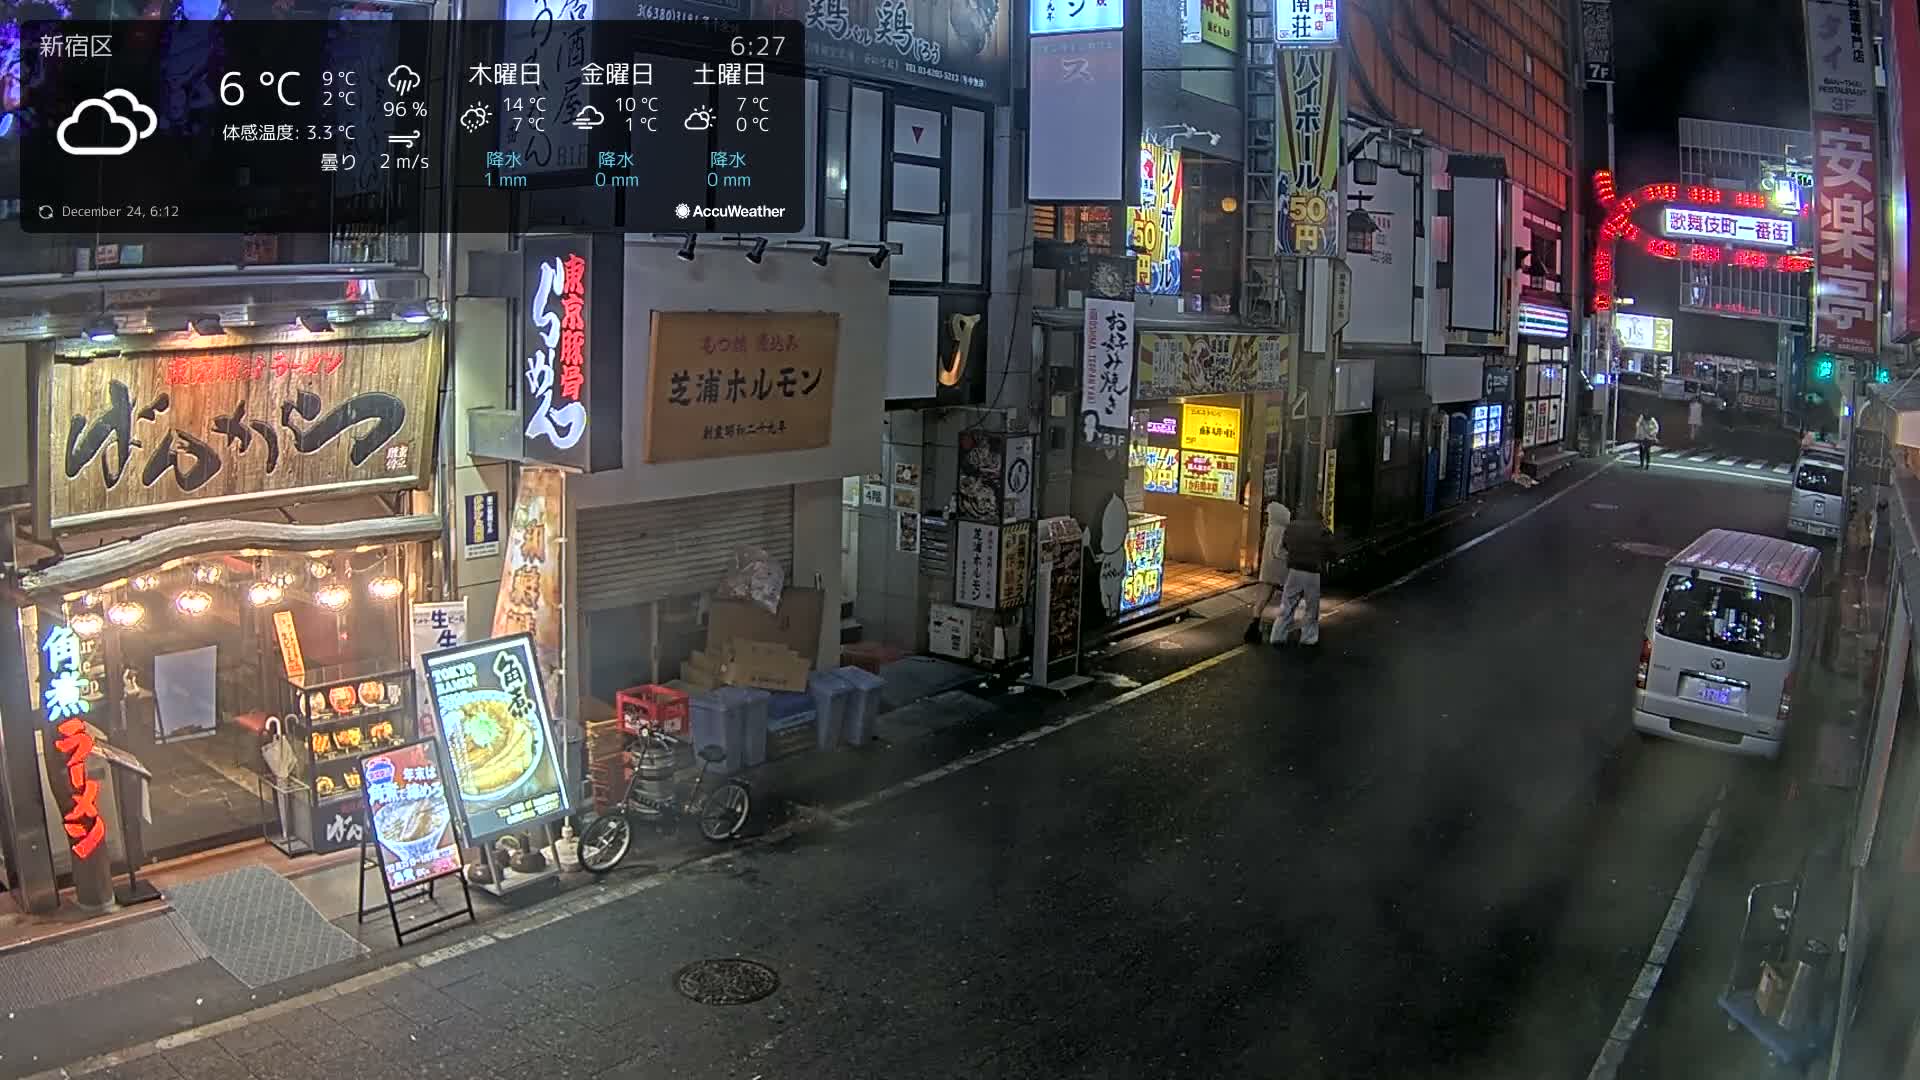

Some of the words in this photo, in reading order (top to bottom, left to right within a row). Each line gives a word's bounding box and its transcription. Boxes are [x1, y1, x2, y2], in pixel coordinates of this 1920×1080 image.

[1590, 64, 1609, 79] 7F
[1295, 51, 1321, 190] ハイボール
[1289, 194, 1328, 223] 50
[1670, 211, 1789, 242] 歌舞伎町一番街
[1819, 126, 1875, 330] 安楽亭
[560, 253, 586, 400] 東京豚骨
[1101, 309, 1130, 416] お好み焼き
[666, 366, 823, 407] 芝浦ホルモン
[66, 379, 406, 491] ばんから
[497, 655, 533, 719] 角煮
